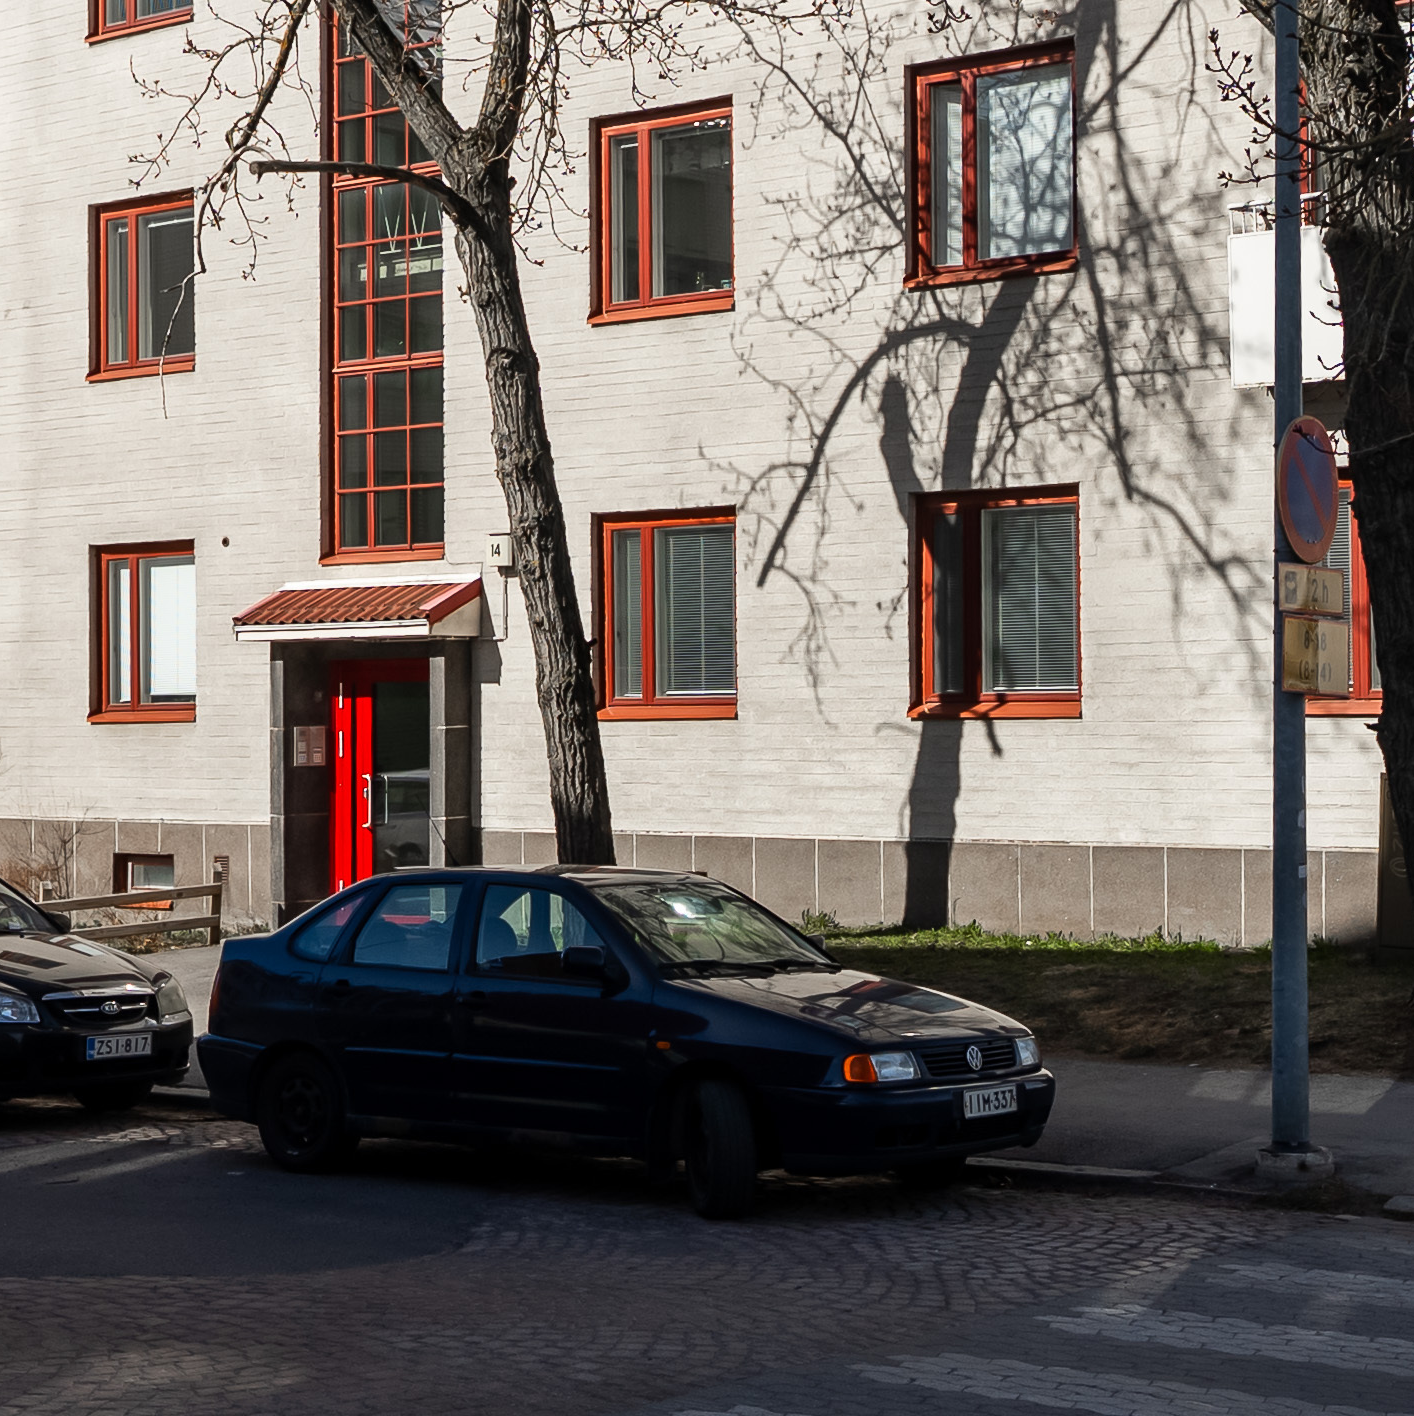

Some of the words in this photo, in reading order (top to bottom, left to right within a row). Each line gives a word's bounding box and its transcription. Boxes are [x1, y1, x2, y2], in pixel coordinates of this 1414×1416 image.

[491, 543, 501, 557] 14
[1311, 578, 1318, 603] 2
[1322, 579, 1329, 603] h
[104, 1004, 119, 1012] KIA
